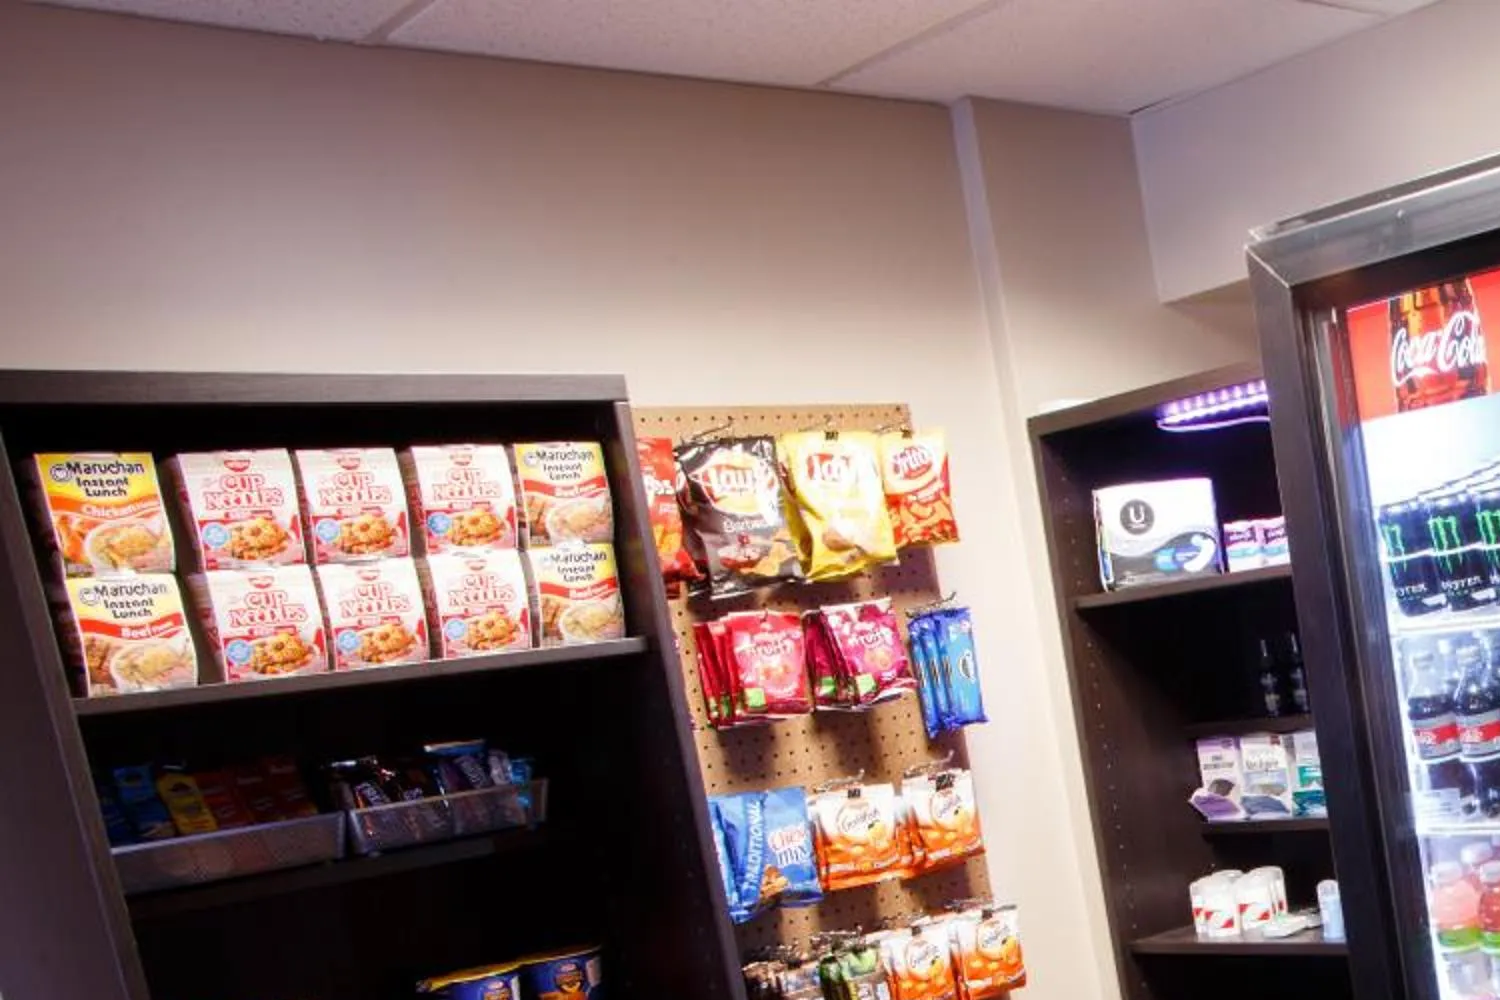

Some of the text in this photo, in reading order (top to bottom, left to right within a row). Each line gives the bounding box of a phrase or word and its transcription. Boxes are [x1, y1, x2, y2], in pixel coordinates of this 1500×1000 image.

[1391, 310, 1487, 386] Coca-Cola
[536, 450, 595, 461] Maruchan
[68, 461, 145, 475] Maruchan
[75, 476, 129, 487] Instant
[85, 487, 127, 497] Lunch
[96, 582, 168, 597] Maruchan
[104, 599, 154, 609] Instant
[112, 609, 152, 618] Lunch
